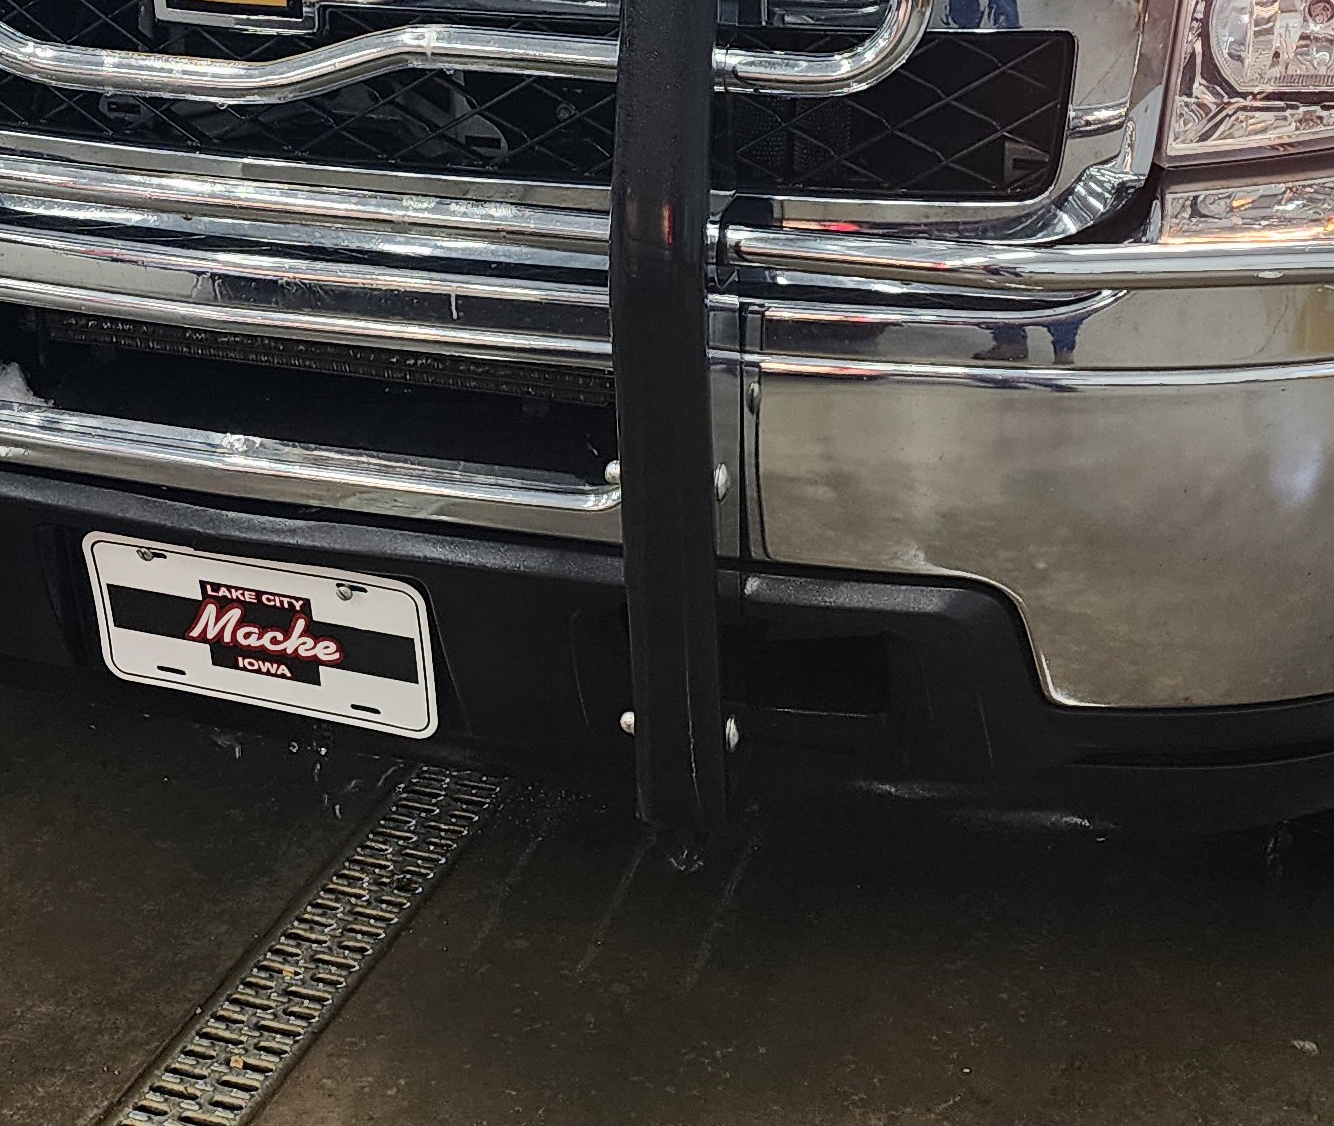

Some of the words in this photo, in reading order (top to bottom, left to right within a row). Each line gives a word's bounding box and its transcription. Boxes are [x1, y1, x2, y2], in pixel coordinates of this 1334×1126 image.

[206, 584, 257, 603] LAKE
[261, 593, 304, 611] CITY
[188, 602, 341, 661] Macke
[237, 656, 292, 678] IOWA
